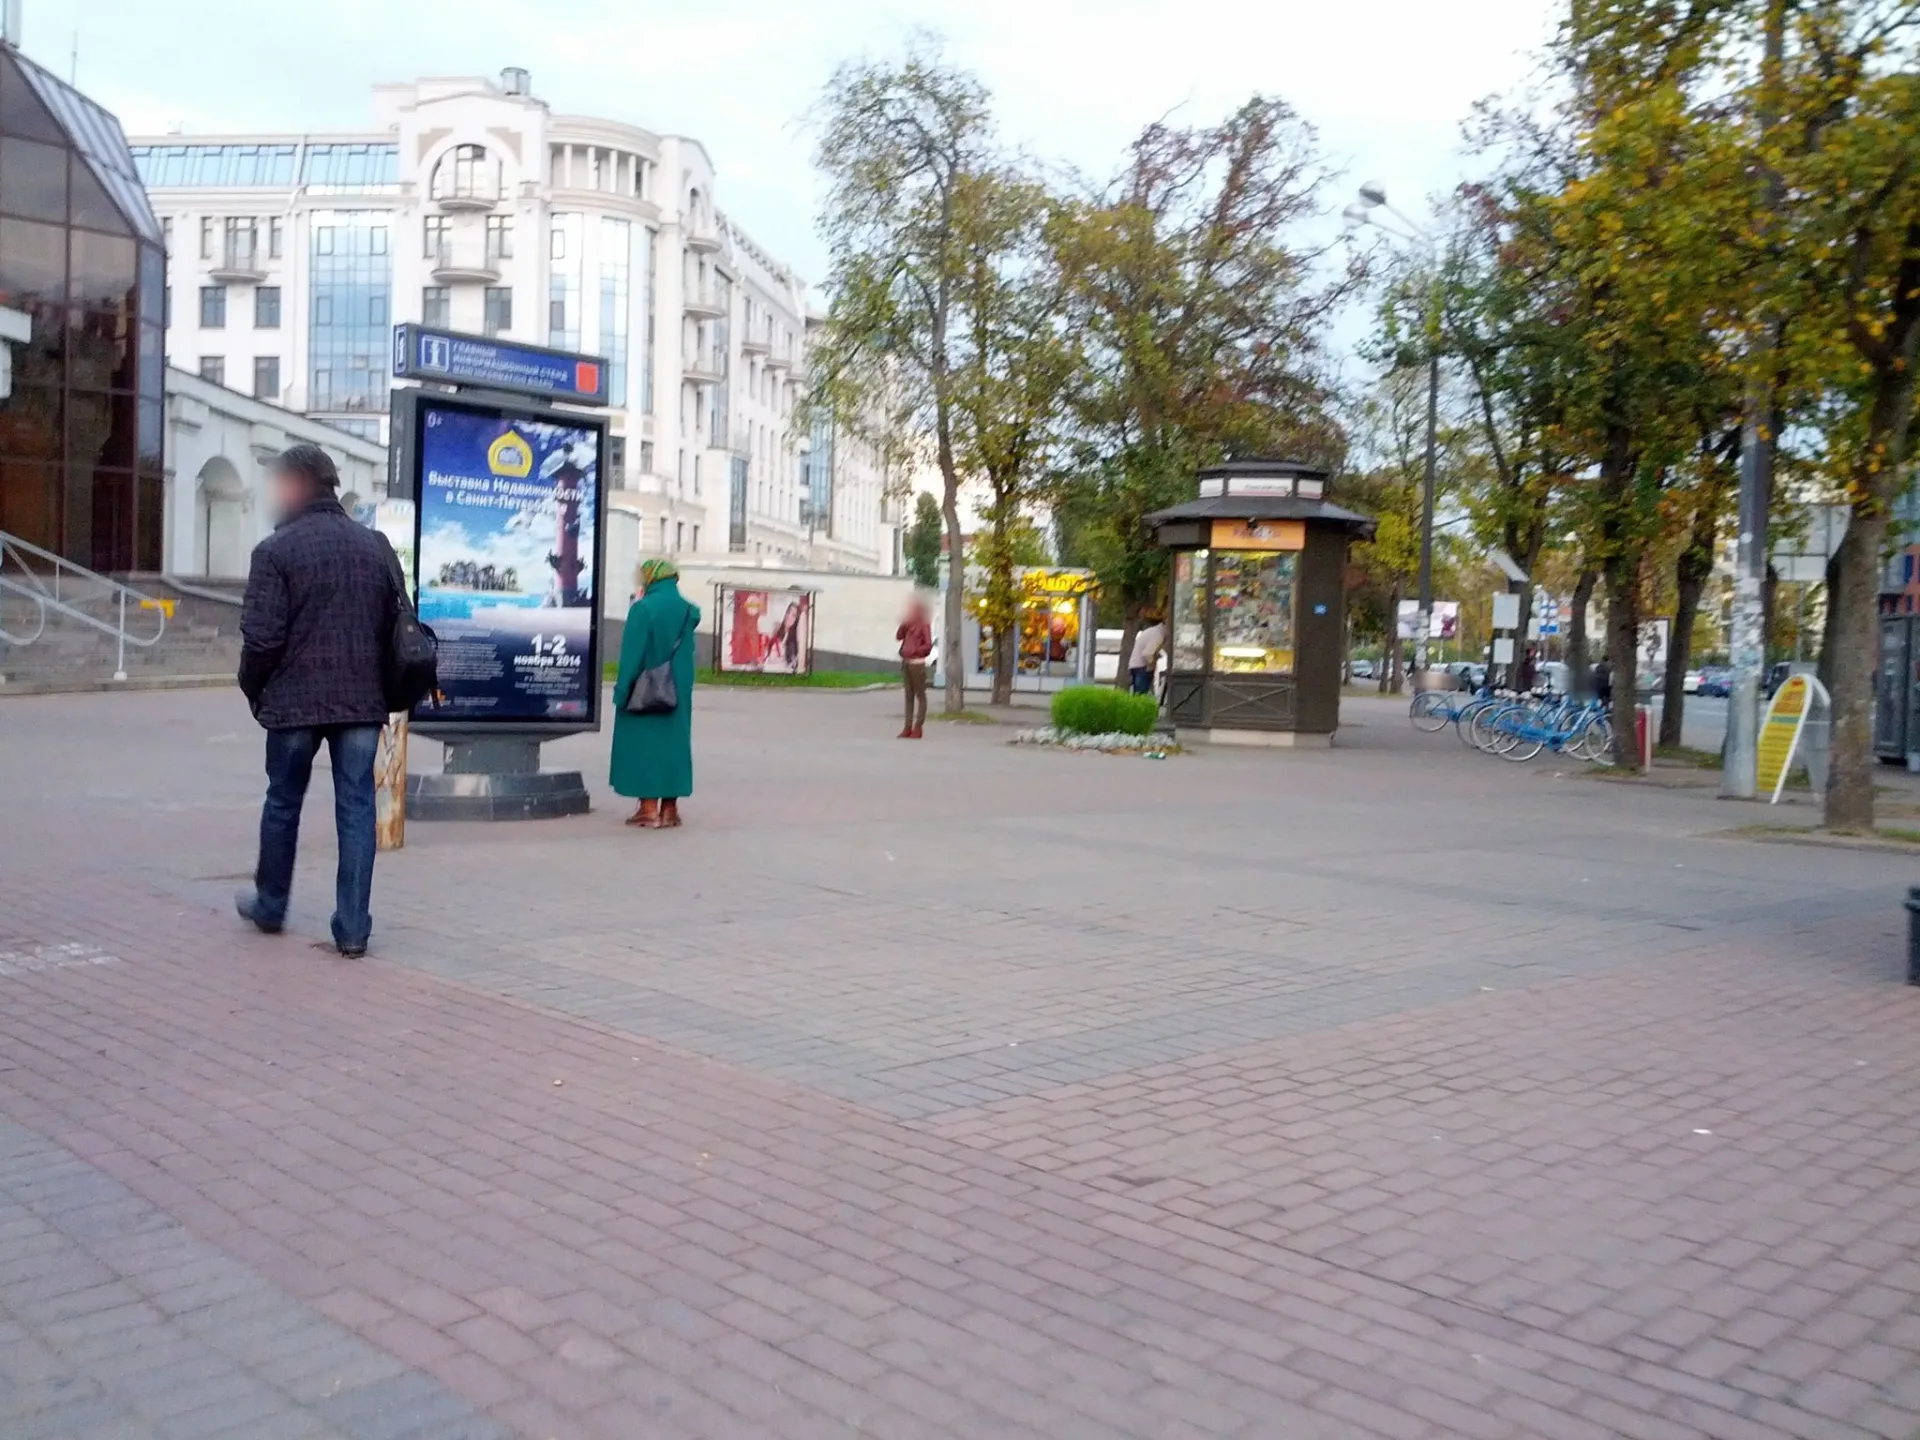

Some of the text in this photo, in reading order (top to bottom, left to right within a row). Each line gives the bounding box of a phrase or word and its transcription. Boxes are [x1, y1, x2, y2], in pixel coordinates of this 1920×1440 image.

[428, 470, 584, 501] Выставка Недвижимости
[531, 633, 566, 655] 1-2
[513, 653, 581, 668] ноября 2014
